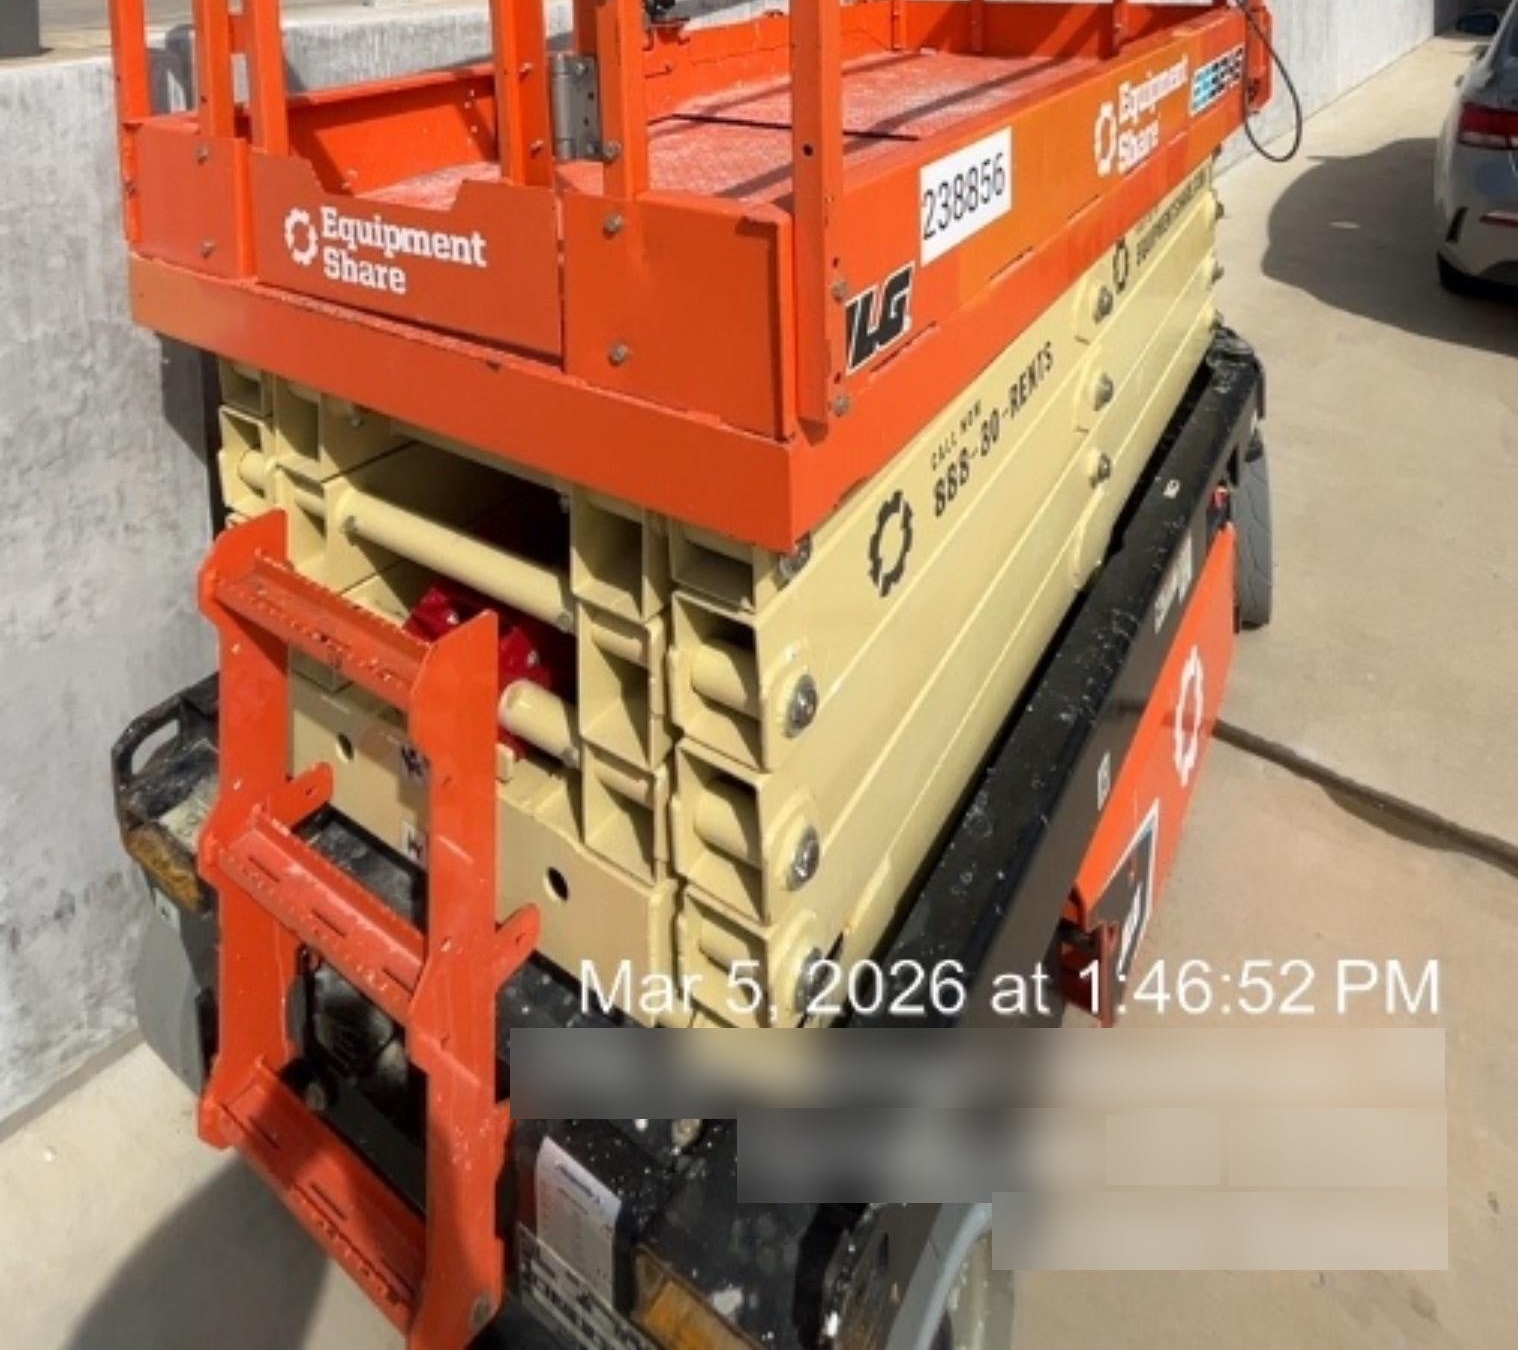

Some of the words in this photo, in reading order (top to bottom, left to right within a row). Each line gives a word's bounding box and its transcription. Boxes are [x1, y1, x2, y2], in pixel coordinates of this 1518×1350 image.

[923, 153, 1005, 240] 238856
[320, 206, 487, 268] Equipment
[323, 247, 406, 294] Share
